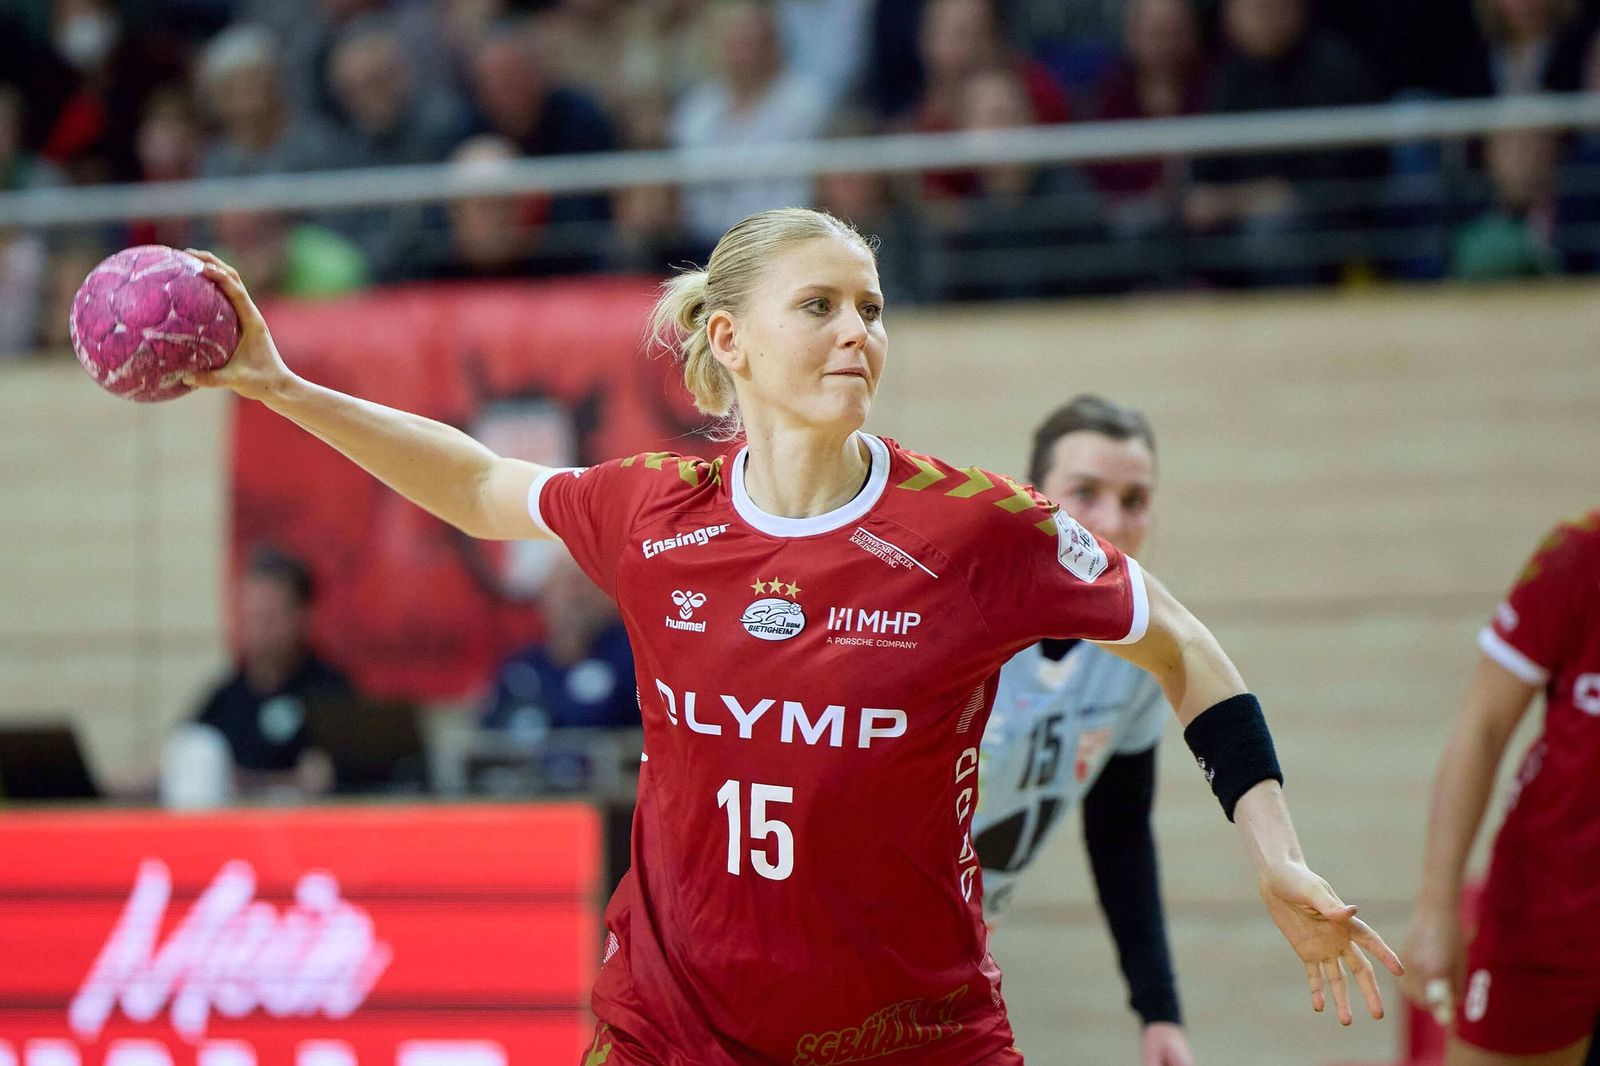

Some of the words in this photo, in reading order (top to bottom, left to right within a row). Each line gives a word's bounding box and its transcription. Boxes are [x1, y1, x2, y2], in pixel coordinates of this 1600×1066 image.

[642, 523, 730, 559] Ensinger
[849, 535, 899, 569] KREISZEITUNG
[853, 529, 915, 570] LUDWIGSBURGER
[665, 616, 706, 632] hummel
[748, 624, 794, 636] BIETIGHEIM
[857, 608, 921, 635] MHP
[835, 637, 874, 647] PORSCHE
[876, 639, 918, 649] COMPANY
[1016, 711, 1065, 790] 15
[716, 779, 794, 881] 15
